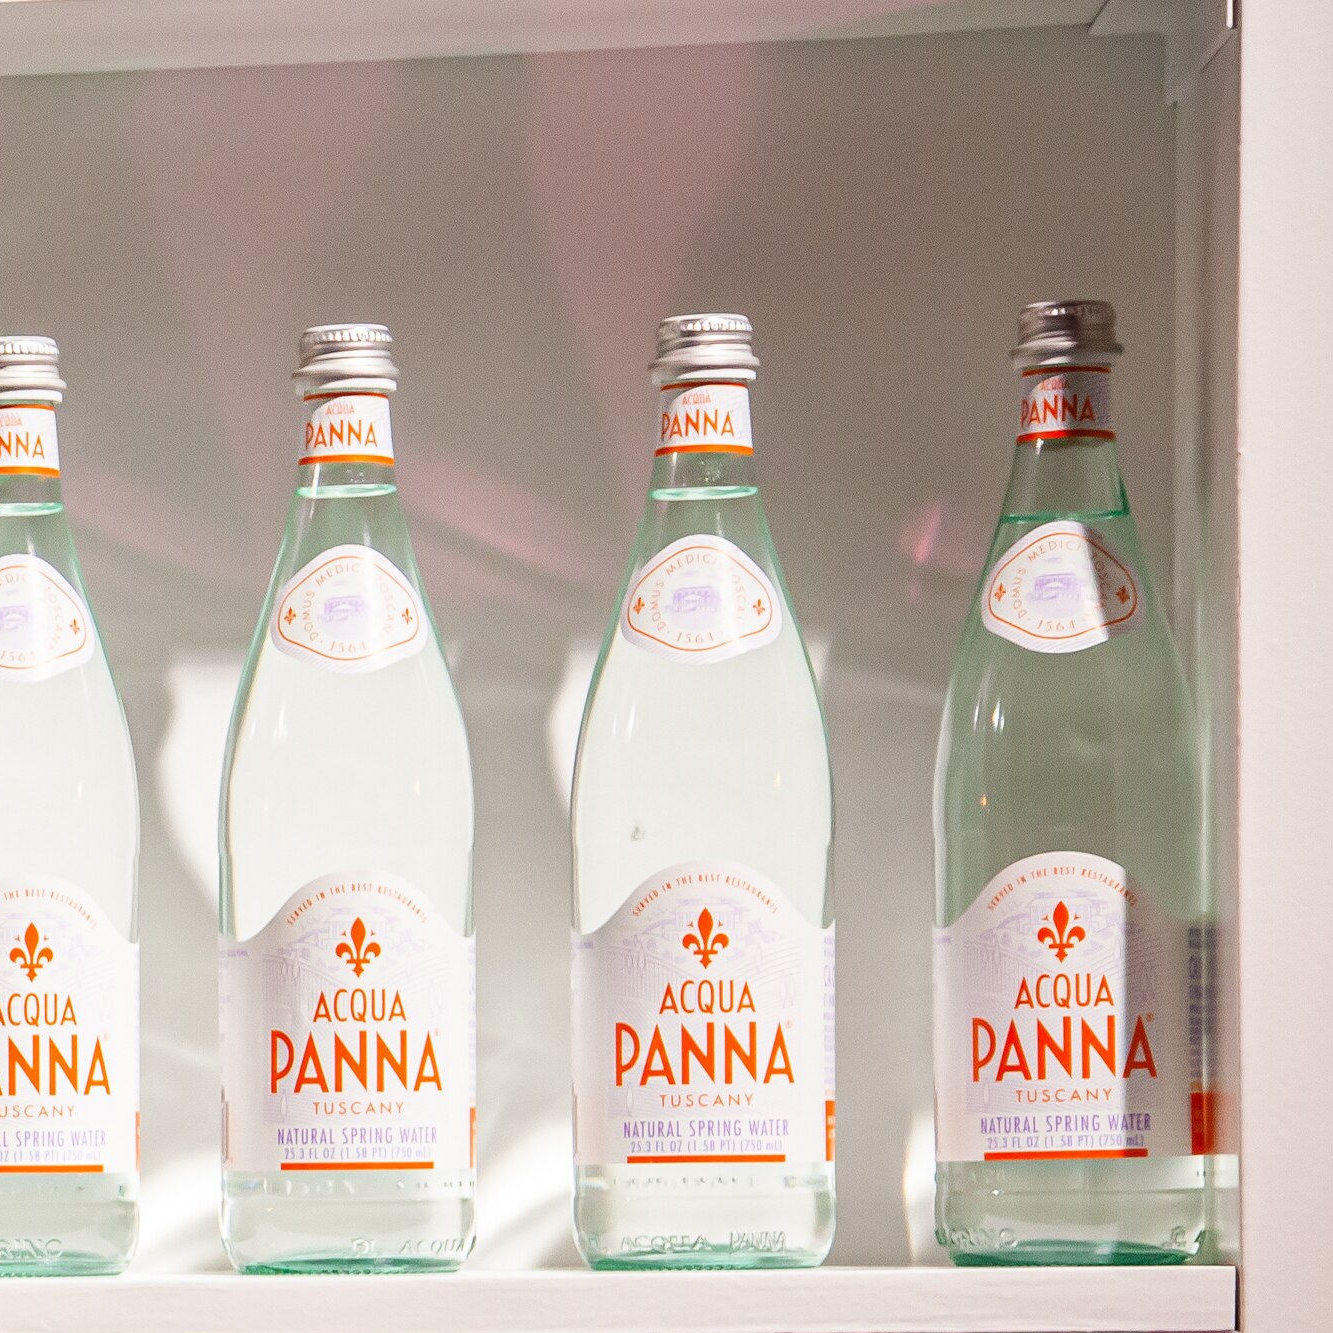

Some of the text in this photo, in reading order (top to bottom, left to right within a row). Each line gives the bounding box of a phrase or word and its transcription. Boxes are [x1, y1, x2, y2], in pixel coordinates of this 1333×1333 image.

[662, 408, 734, 438] PANNA
[1021, 392, 1095, 425] PANNA
[306, 419, 377, 449] PANNA
[313, 989, 405, 1022] ACQUA
[660, 980, 755, 1014] ACQUA
[1015, 974, 1113, 1008] ACQUA
[271, 1030, 442, 1094] PANNA
[616, 1022, 794, 1087] PANNA
[973, 1015, 1156, 1082] PANNA
[313, 1101, 402, 1116] TUSCANY
[661, 1093, 752, 1109] TUSCANY
[1016, 1088, 1111, 1103] TUSCANY
[275, 1126, 440, 1145] NATURAL SPRING WATER
[620, 1119, 791, 1138] NATURAL SPRING WATER
[978, 1113, 1153, 1134] NATURAL SPRING WATER
[15, 1130, 64, 1148] SPRING
[69, 1130, 108, 1146] WATER
